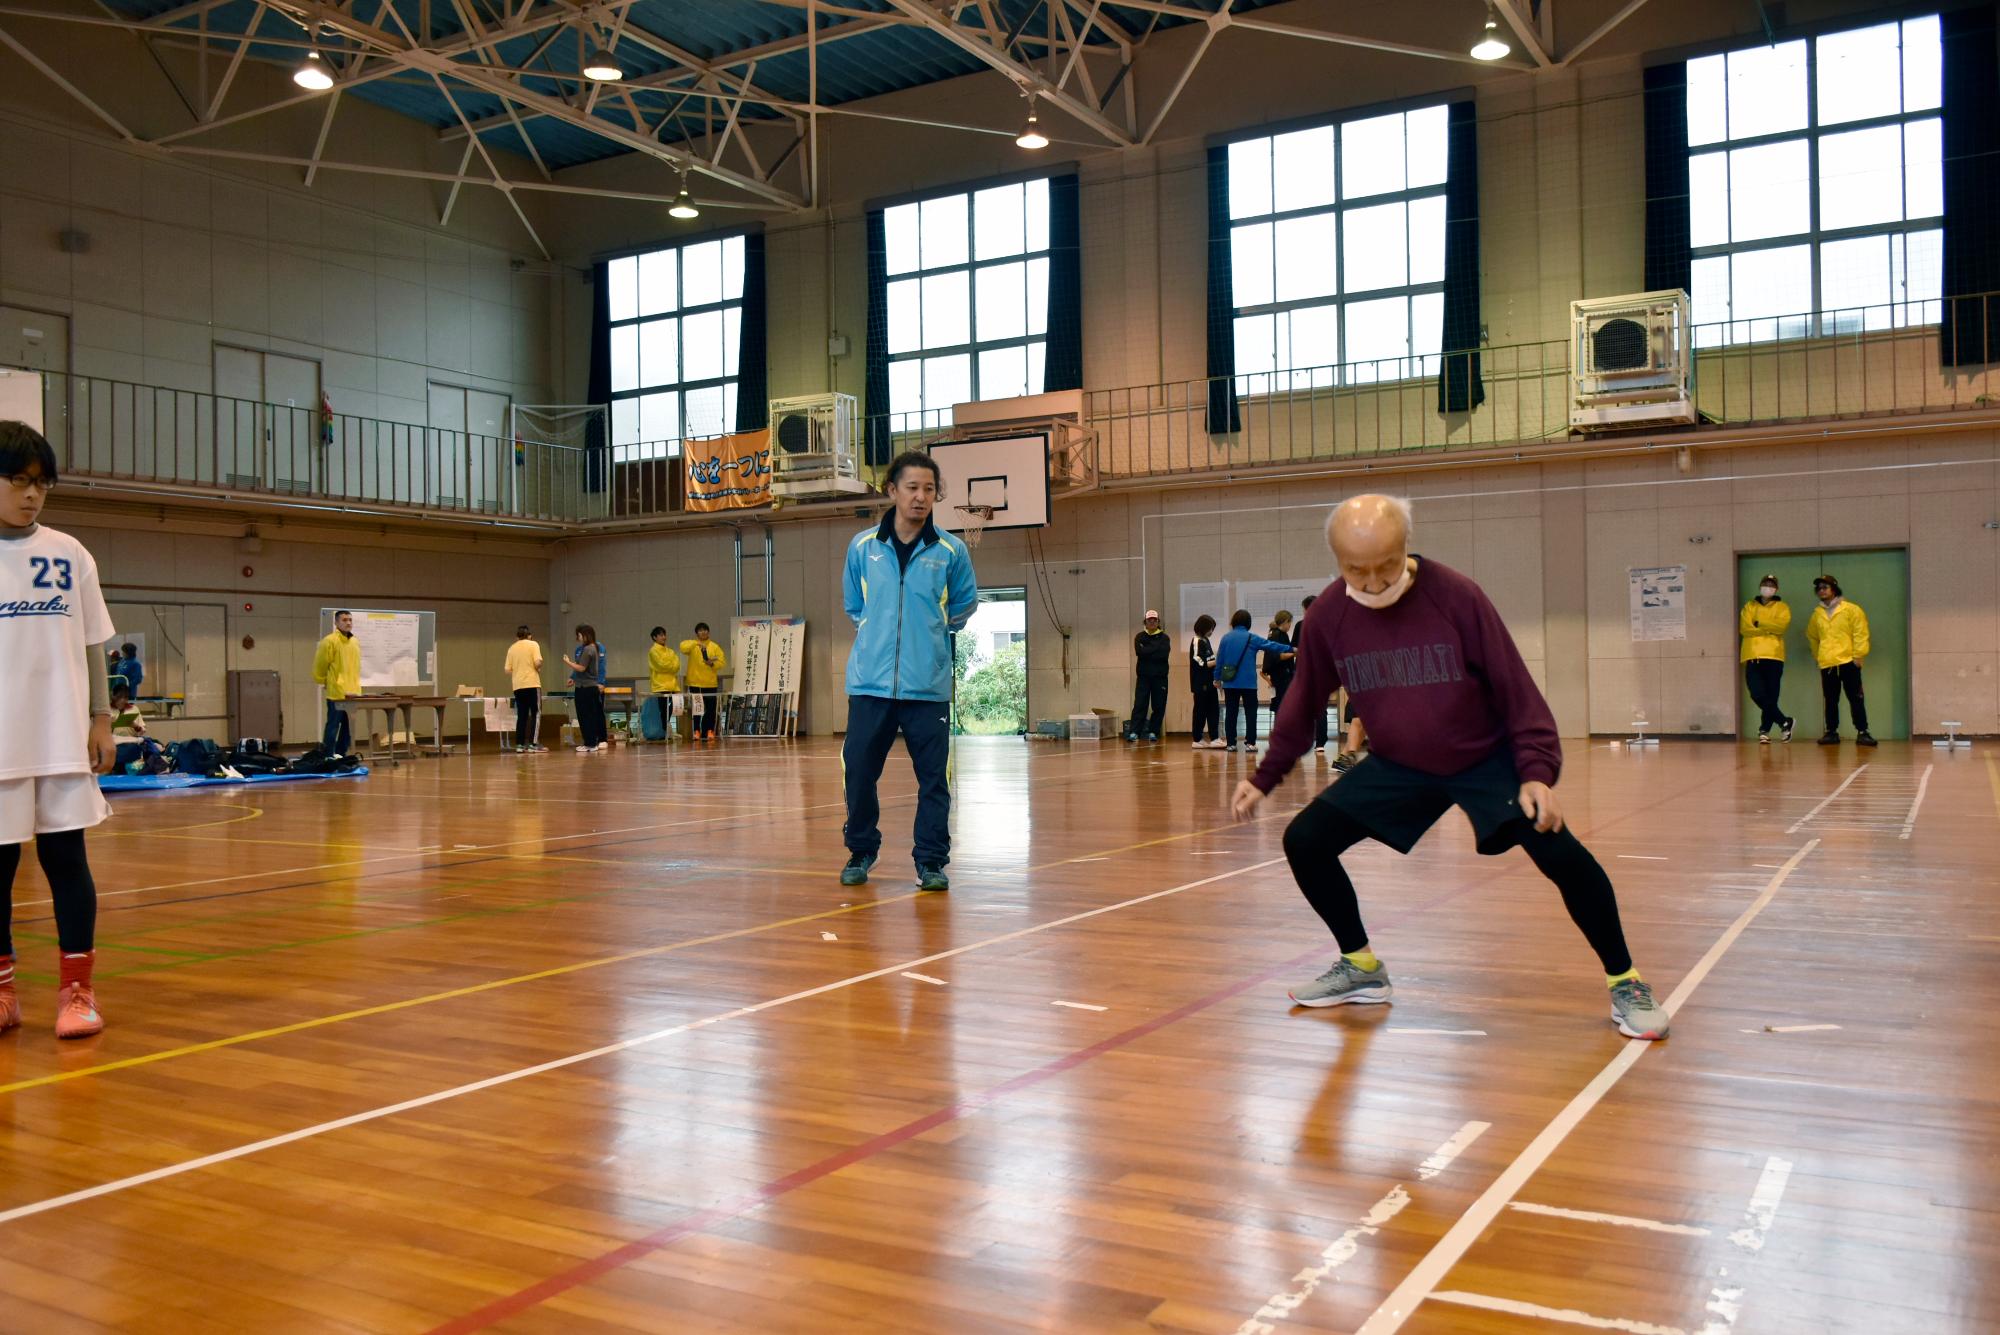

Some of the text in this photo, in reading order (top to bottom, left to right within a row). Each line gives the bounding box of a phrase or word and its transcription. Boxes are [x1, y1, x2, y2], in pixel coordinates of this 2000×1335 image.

[688, 450, 770, 484] 心を一つに
[30, 556, 72, 591] 23
[694, 694, 702, 713] 受付
